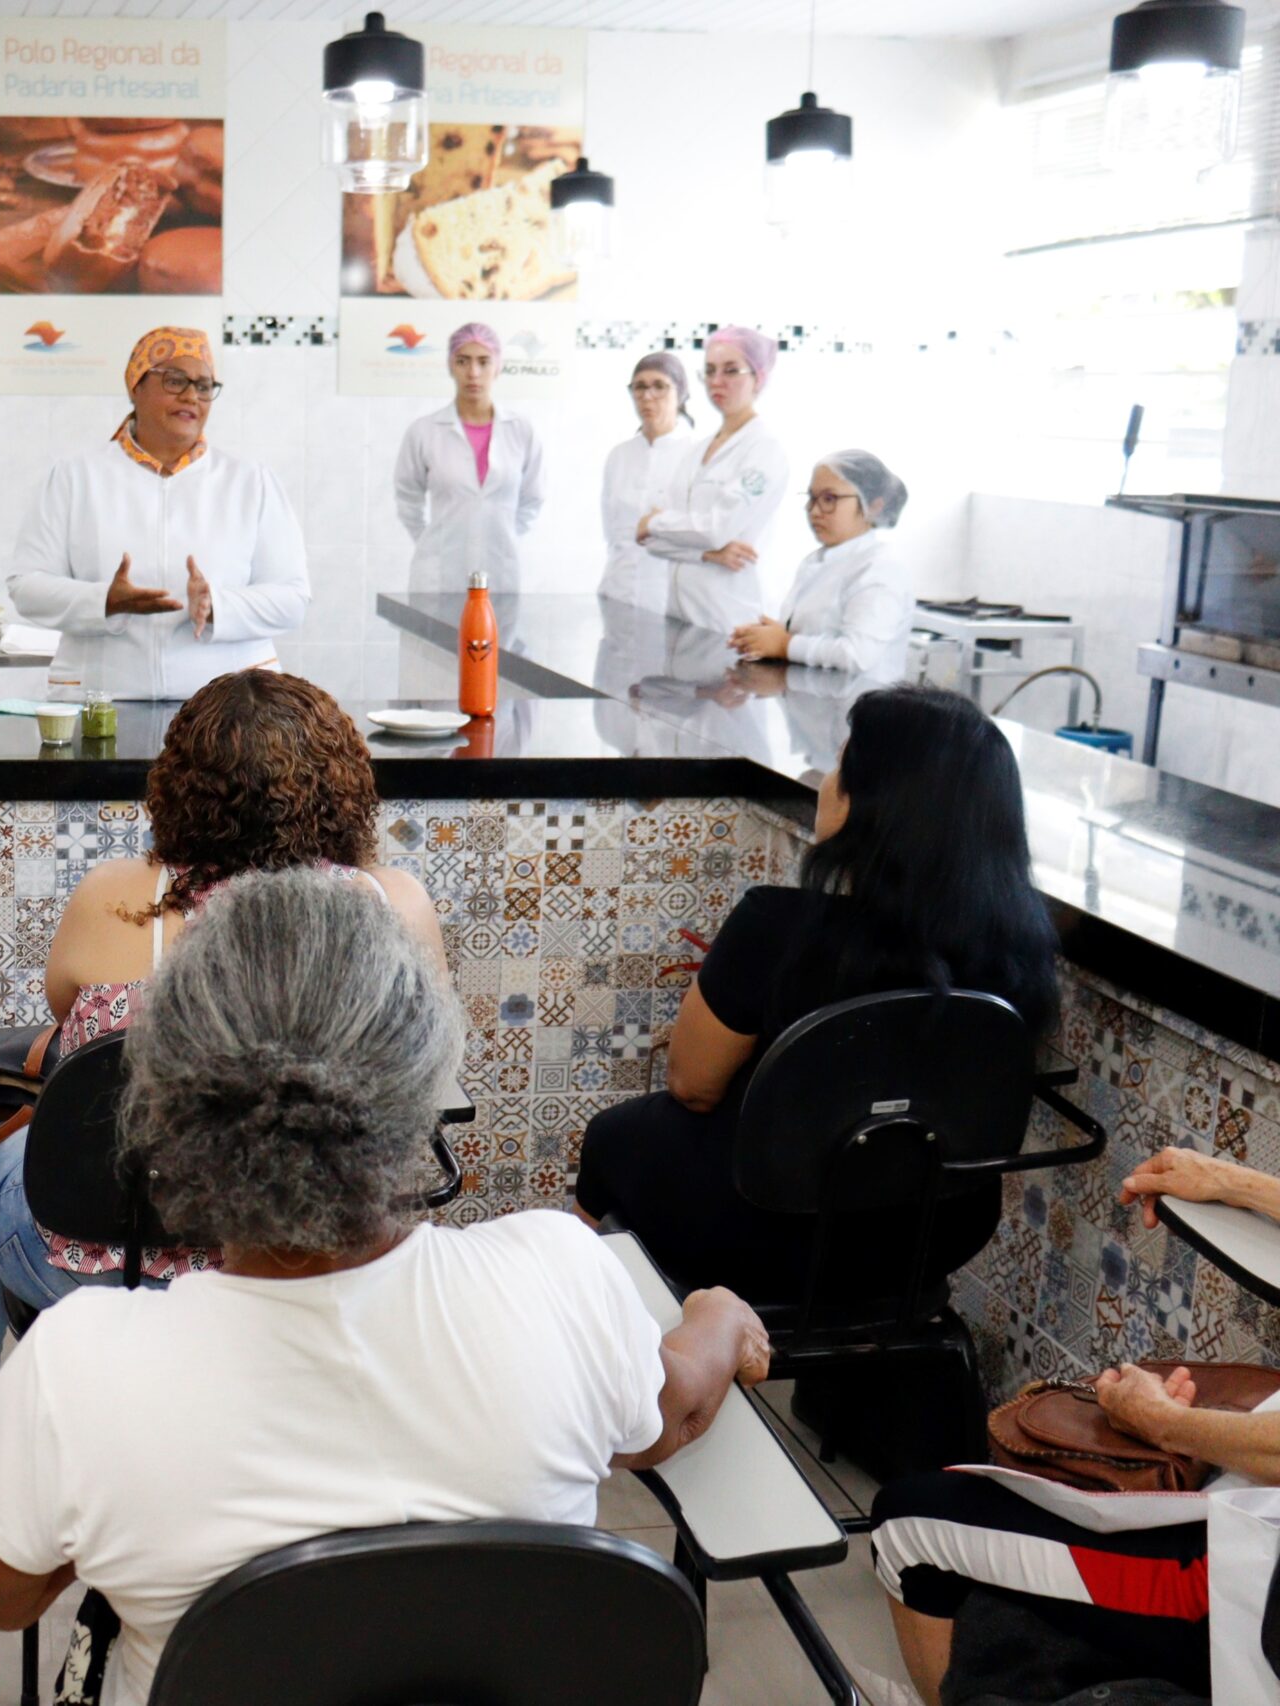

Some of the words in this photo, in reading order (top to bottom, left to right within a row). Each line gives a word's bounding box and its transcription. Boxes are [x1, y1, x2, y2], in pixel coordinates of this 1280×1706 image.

[3, 37, 56, 64] Polo
[62, 37, 163, 71] Regional
[171, 39, 201, 66] da
[428, 46, 529, 79] Regional
[534, 48, 564, 75] da
[3, 73, 87, 98] Padaria
[93, 74, 200, 99] Artesanal
[458, 80, 561, 107] Artesanal
[521, 366, 561, 377] PAULO
